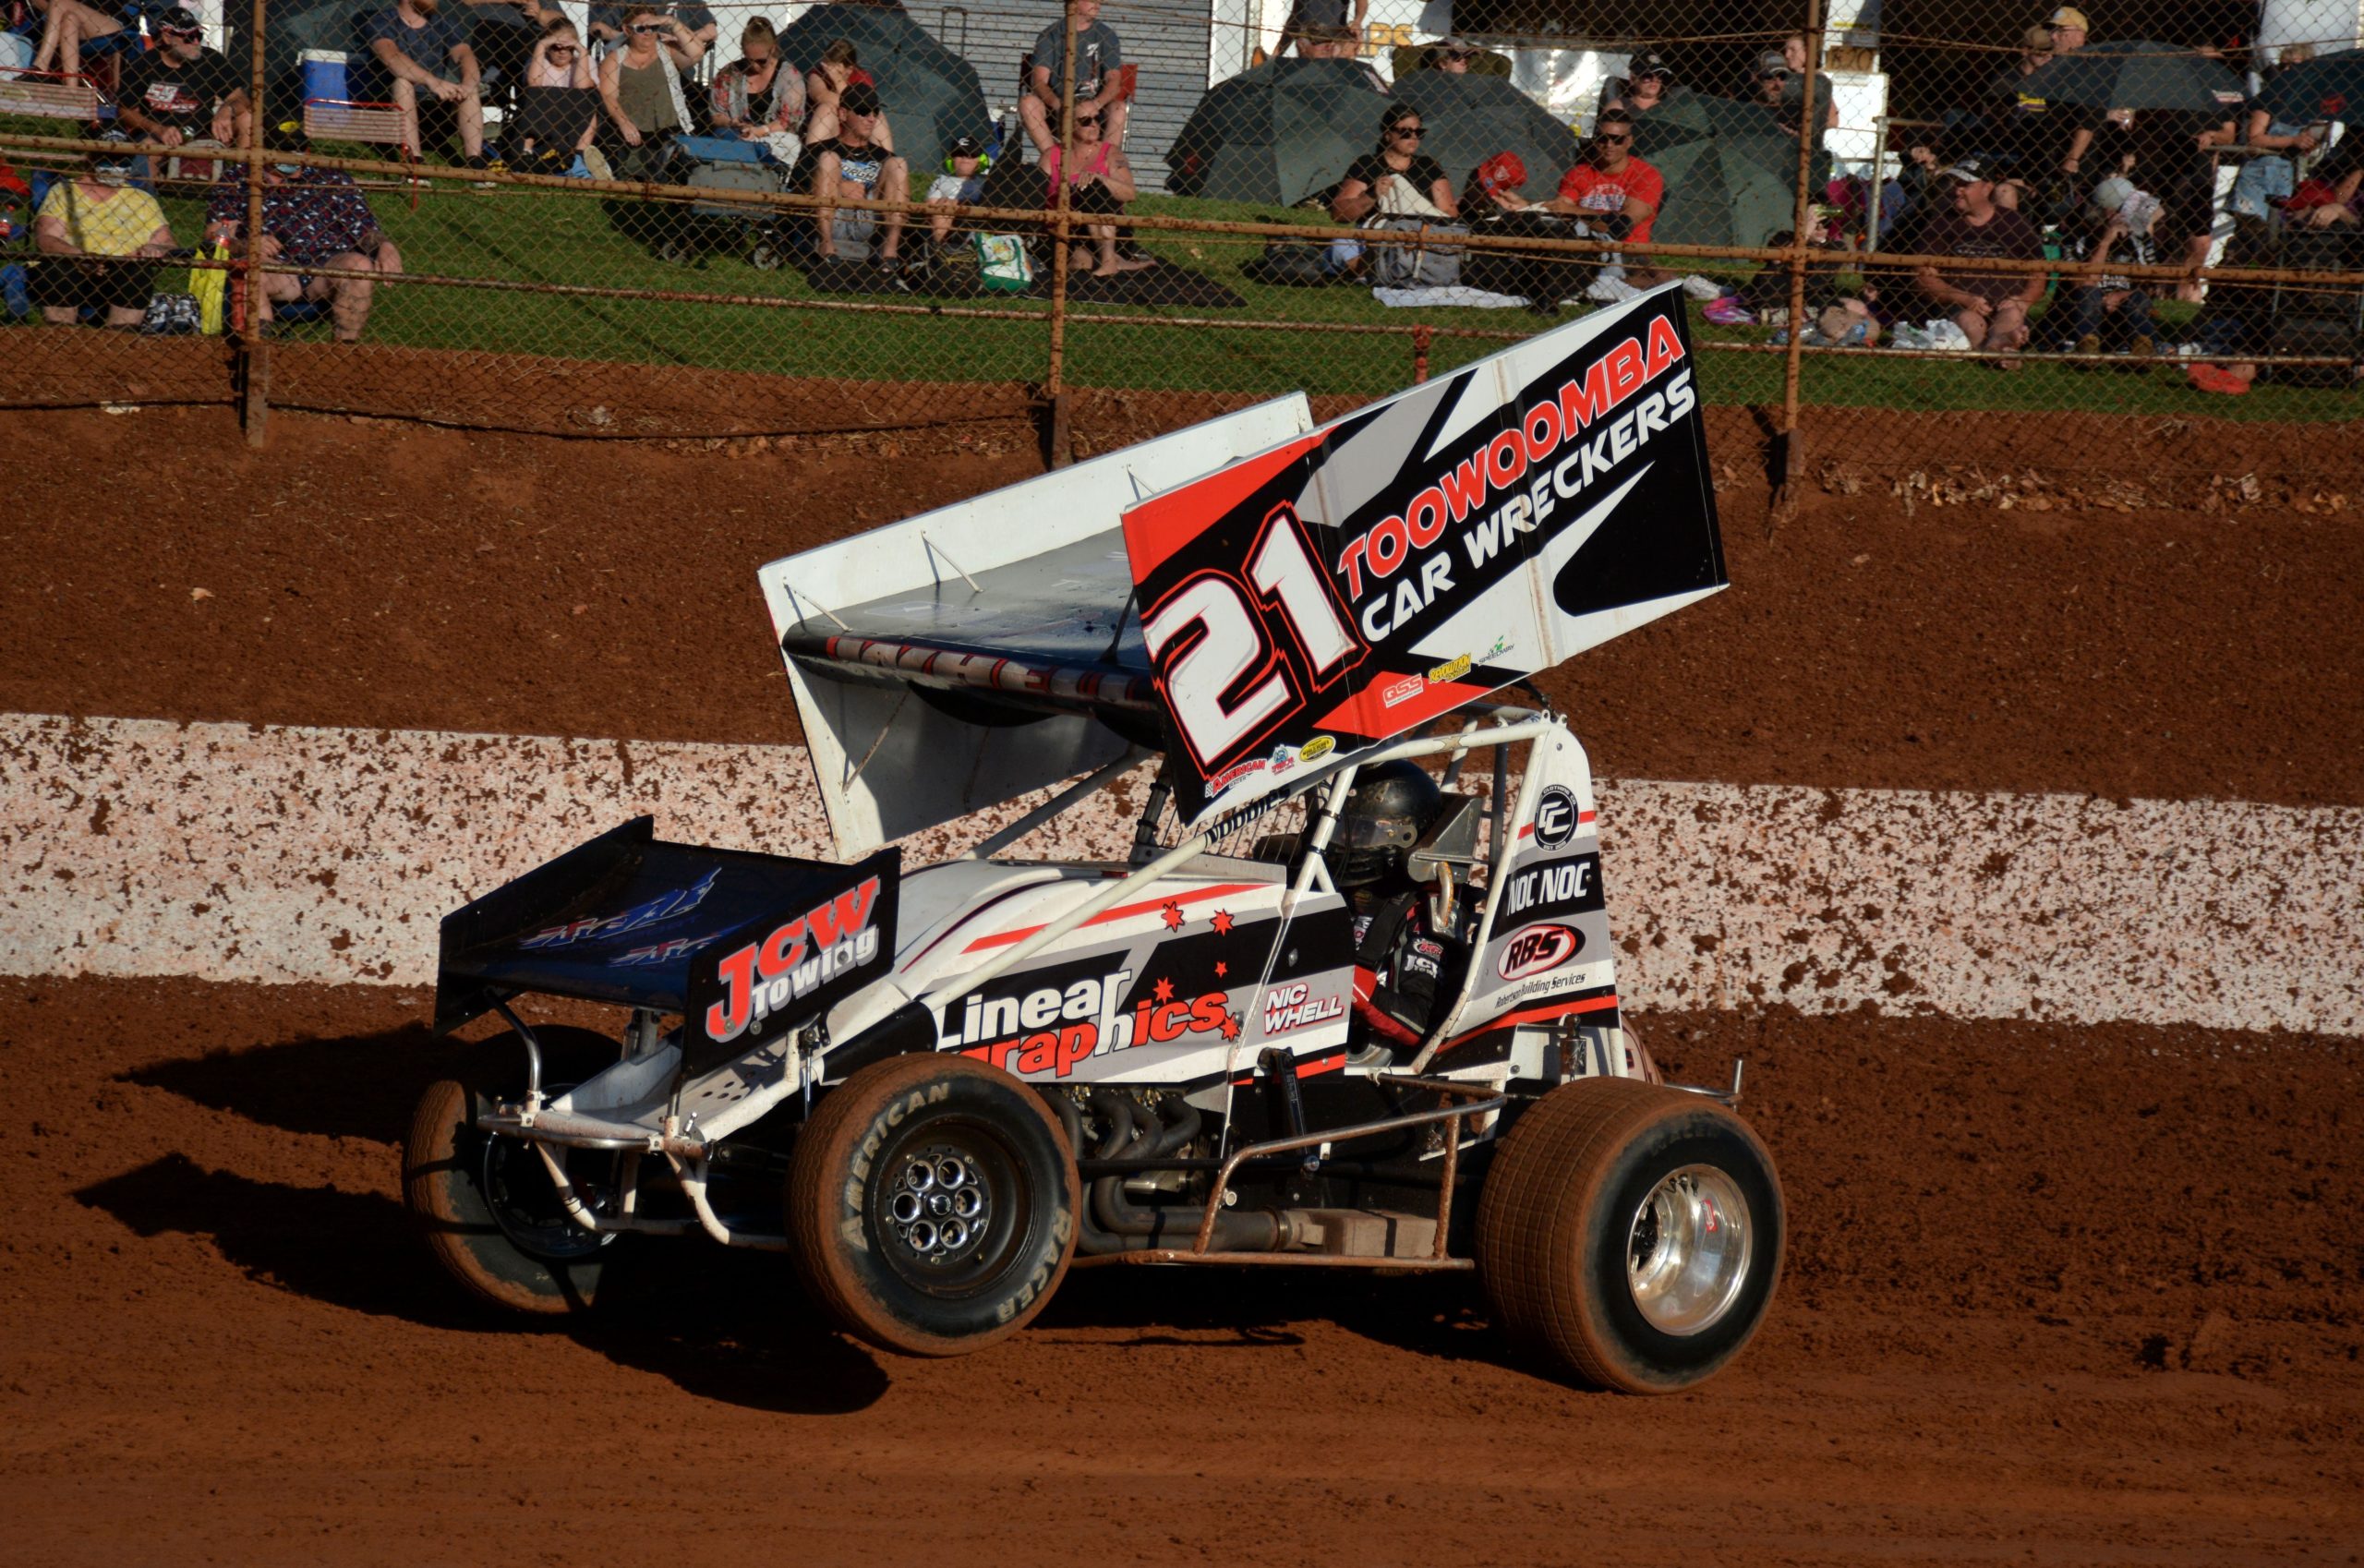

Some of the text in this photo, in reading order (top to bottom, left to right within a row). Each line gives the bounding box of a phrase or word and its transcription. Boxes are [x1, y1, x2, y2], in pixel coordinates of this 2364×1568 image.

[1337, 314, 1685, 603] TOOWOOMBA
[1362, 368, 1695, 642] CAR WRECKERS
[1141, 513, 1358, 767] 21
[1212, 759, 1267, 794] AMERICAN
[1507, 862, 1591, 917] NOC NOC
[706, 875, 880, 1043] JCW
[1504, 928, 1567, 975] RBS
[1522, 977, 1550, 995] Building
[1550, 973, 1586, 991] Services
[936, 970, 1133, 1052] Linear
[1264, 996, 1345, 1035] WHELL
[1265, 983, 1309, 1013] NIC
[838, 1081, 949, 1251] AMERICAN
[995, 1206, 1073, 1324] RACER
